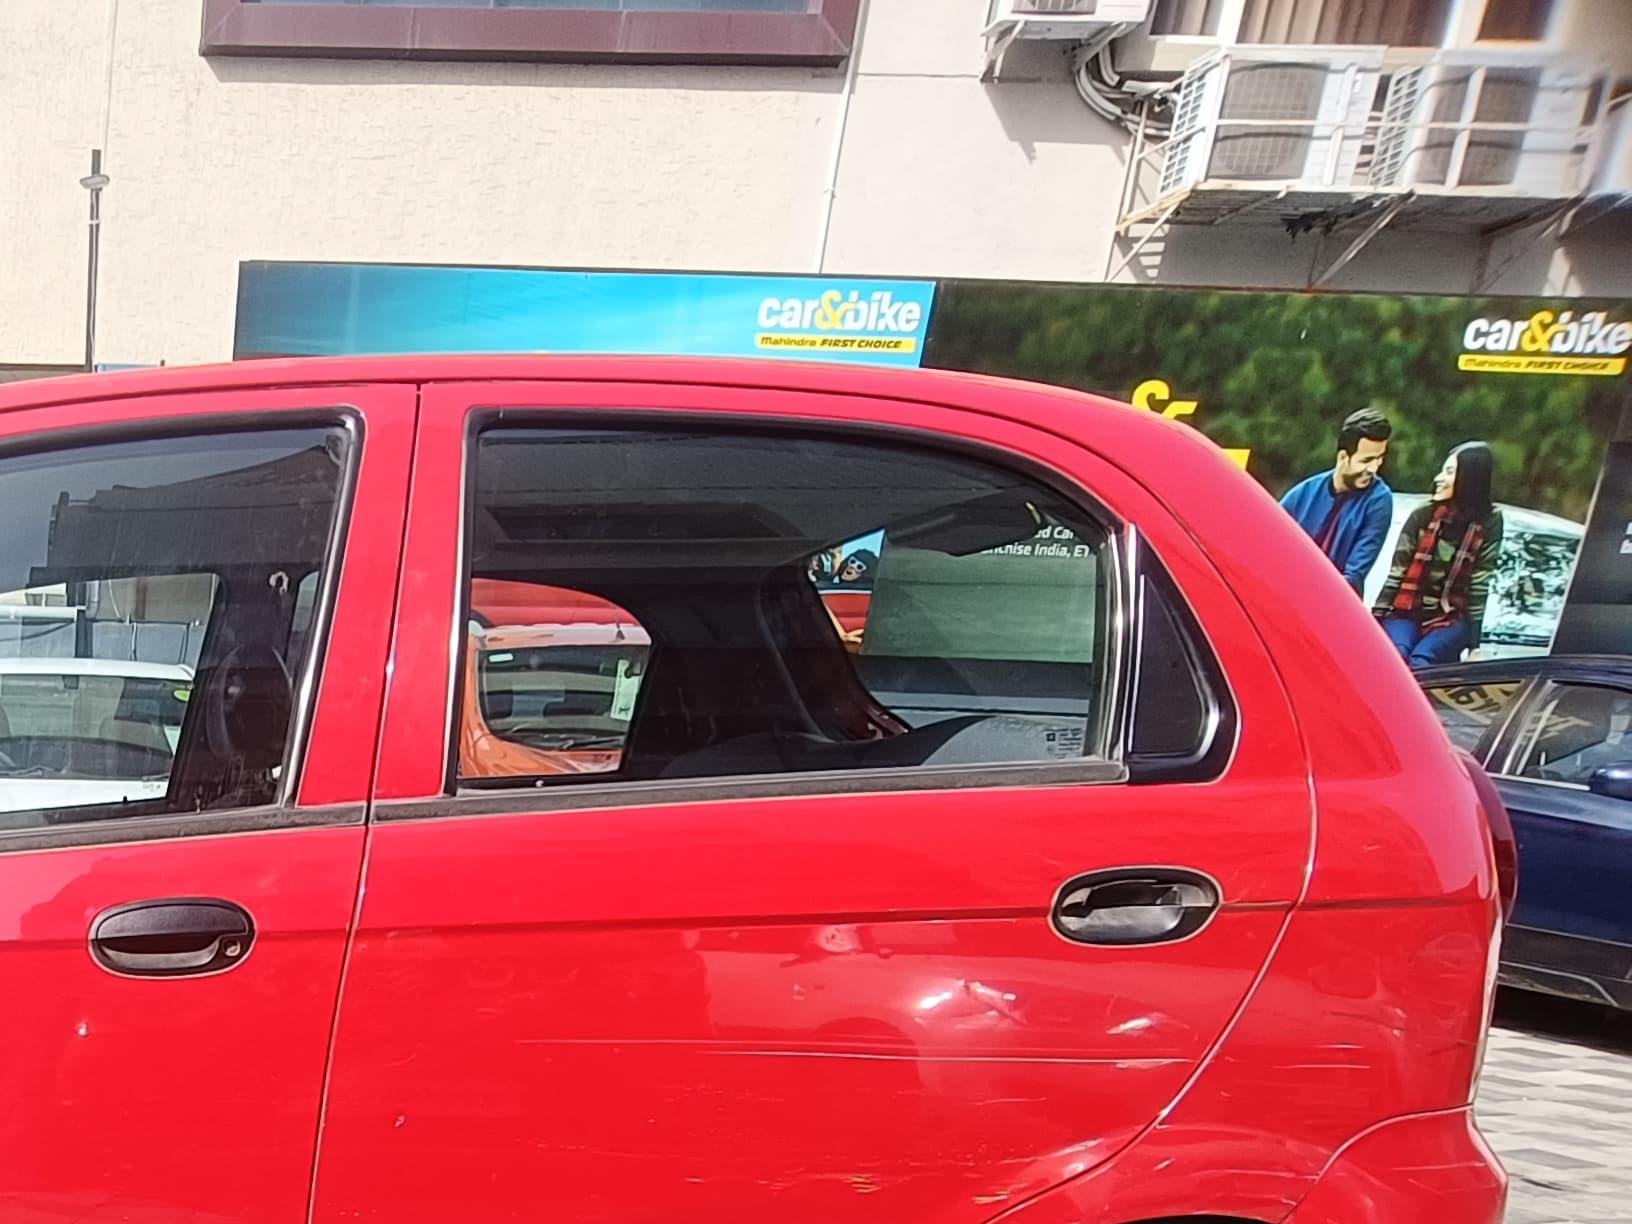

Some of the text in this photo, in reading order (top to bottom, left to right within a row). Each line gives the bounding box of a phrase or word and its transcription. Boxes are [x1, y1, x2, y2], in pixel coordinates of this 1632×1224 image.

[758, 289, 920, 332] car&bike
[1463, 309, 1632, 355] car&bike
[760, 336, 902, 350] Mahindra FIRST CHOICE
[1525, 360, 1561, 370] FIRST
[1034, 543, 1071, 558] India,
